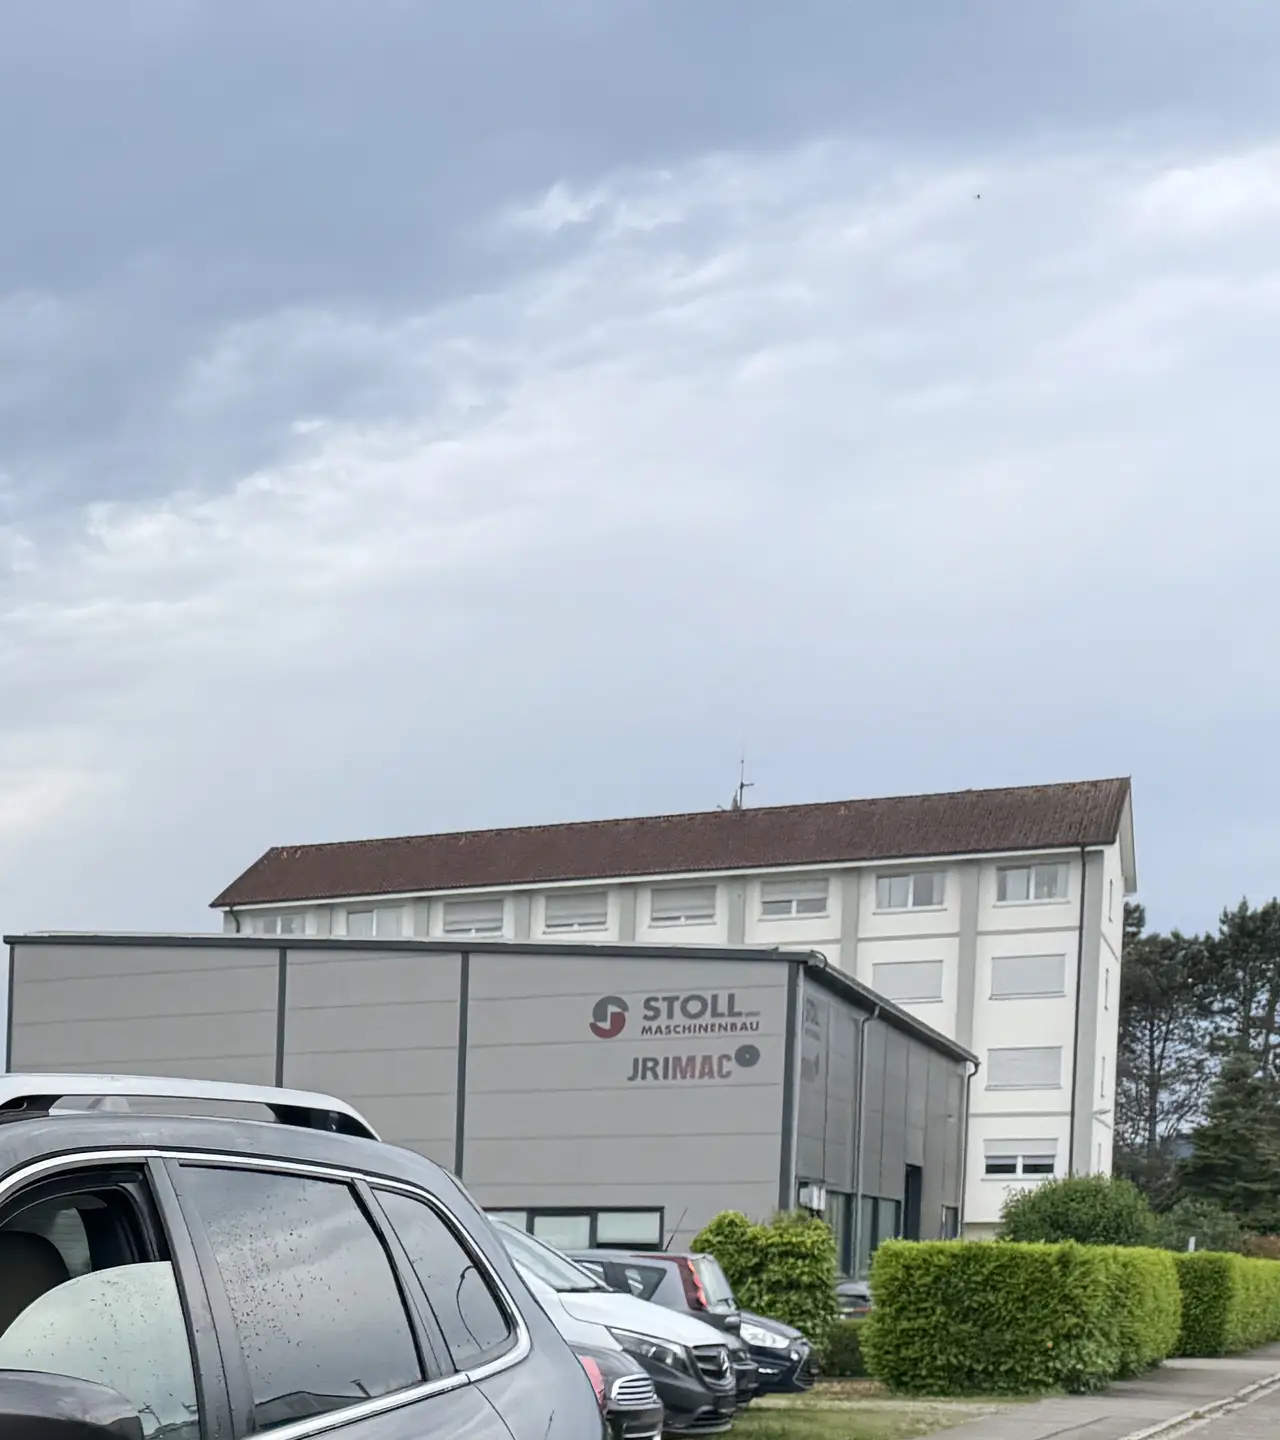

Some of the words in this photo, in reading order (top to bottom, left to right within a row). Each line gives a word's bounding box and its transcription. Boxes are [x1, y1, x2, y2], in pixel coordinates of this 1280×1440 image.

[642, 993, 743, 1021] STOLL
[641, 1020, 760, 1036] MASCHINENBAU
[627, 1054, 733, 1081] JRIMAC
